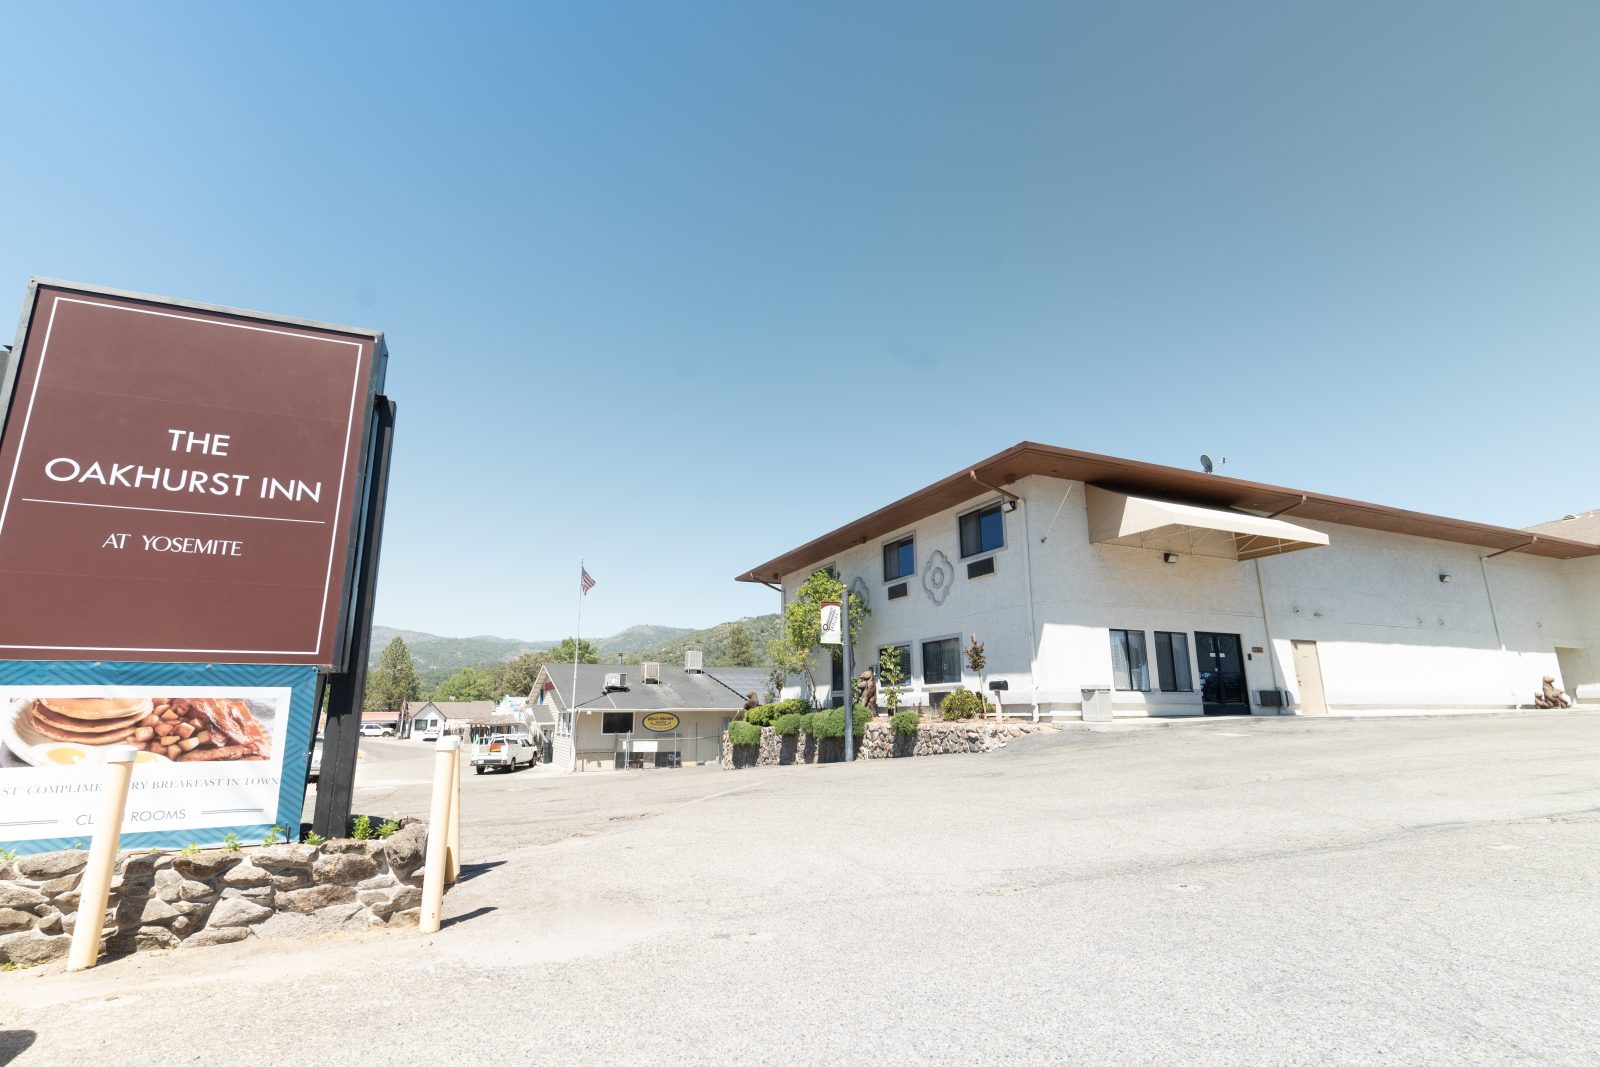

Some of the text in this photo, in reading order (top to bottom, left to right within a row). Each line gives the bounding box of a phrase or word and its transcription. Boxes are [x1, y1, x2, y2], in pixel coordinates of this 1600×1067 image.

[168, 429, 231, 457] THE
[44, 457, 322, 504] OAKHURST INN
[102, 533, 243, 556] AT YOSEMITE
[27, 780, 149, 795] COMPLIMERY
[152, 777, 223, 789] BREAKFAST
[225, 778, 240, 787] IN
[244, 776, 279, 787] TOWN
[131, 808, 187, 822] ROOMS
